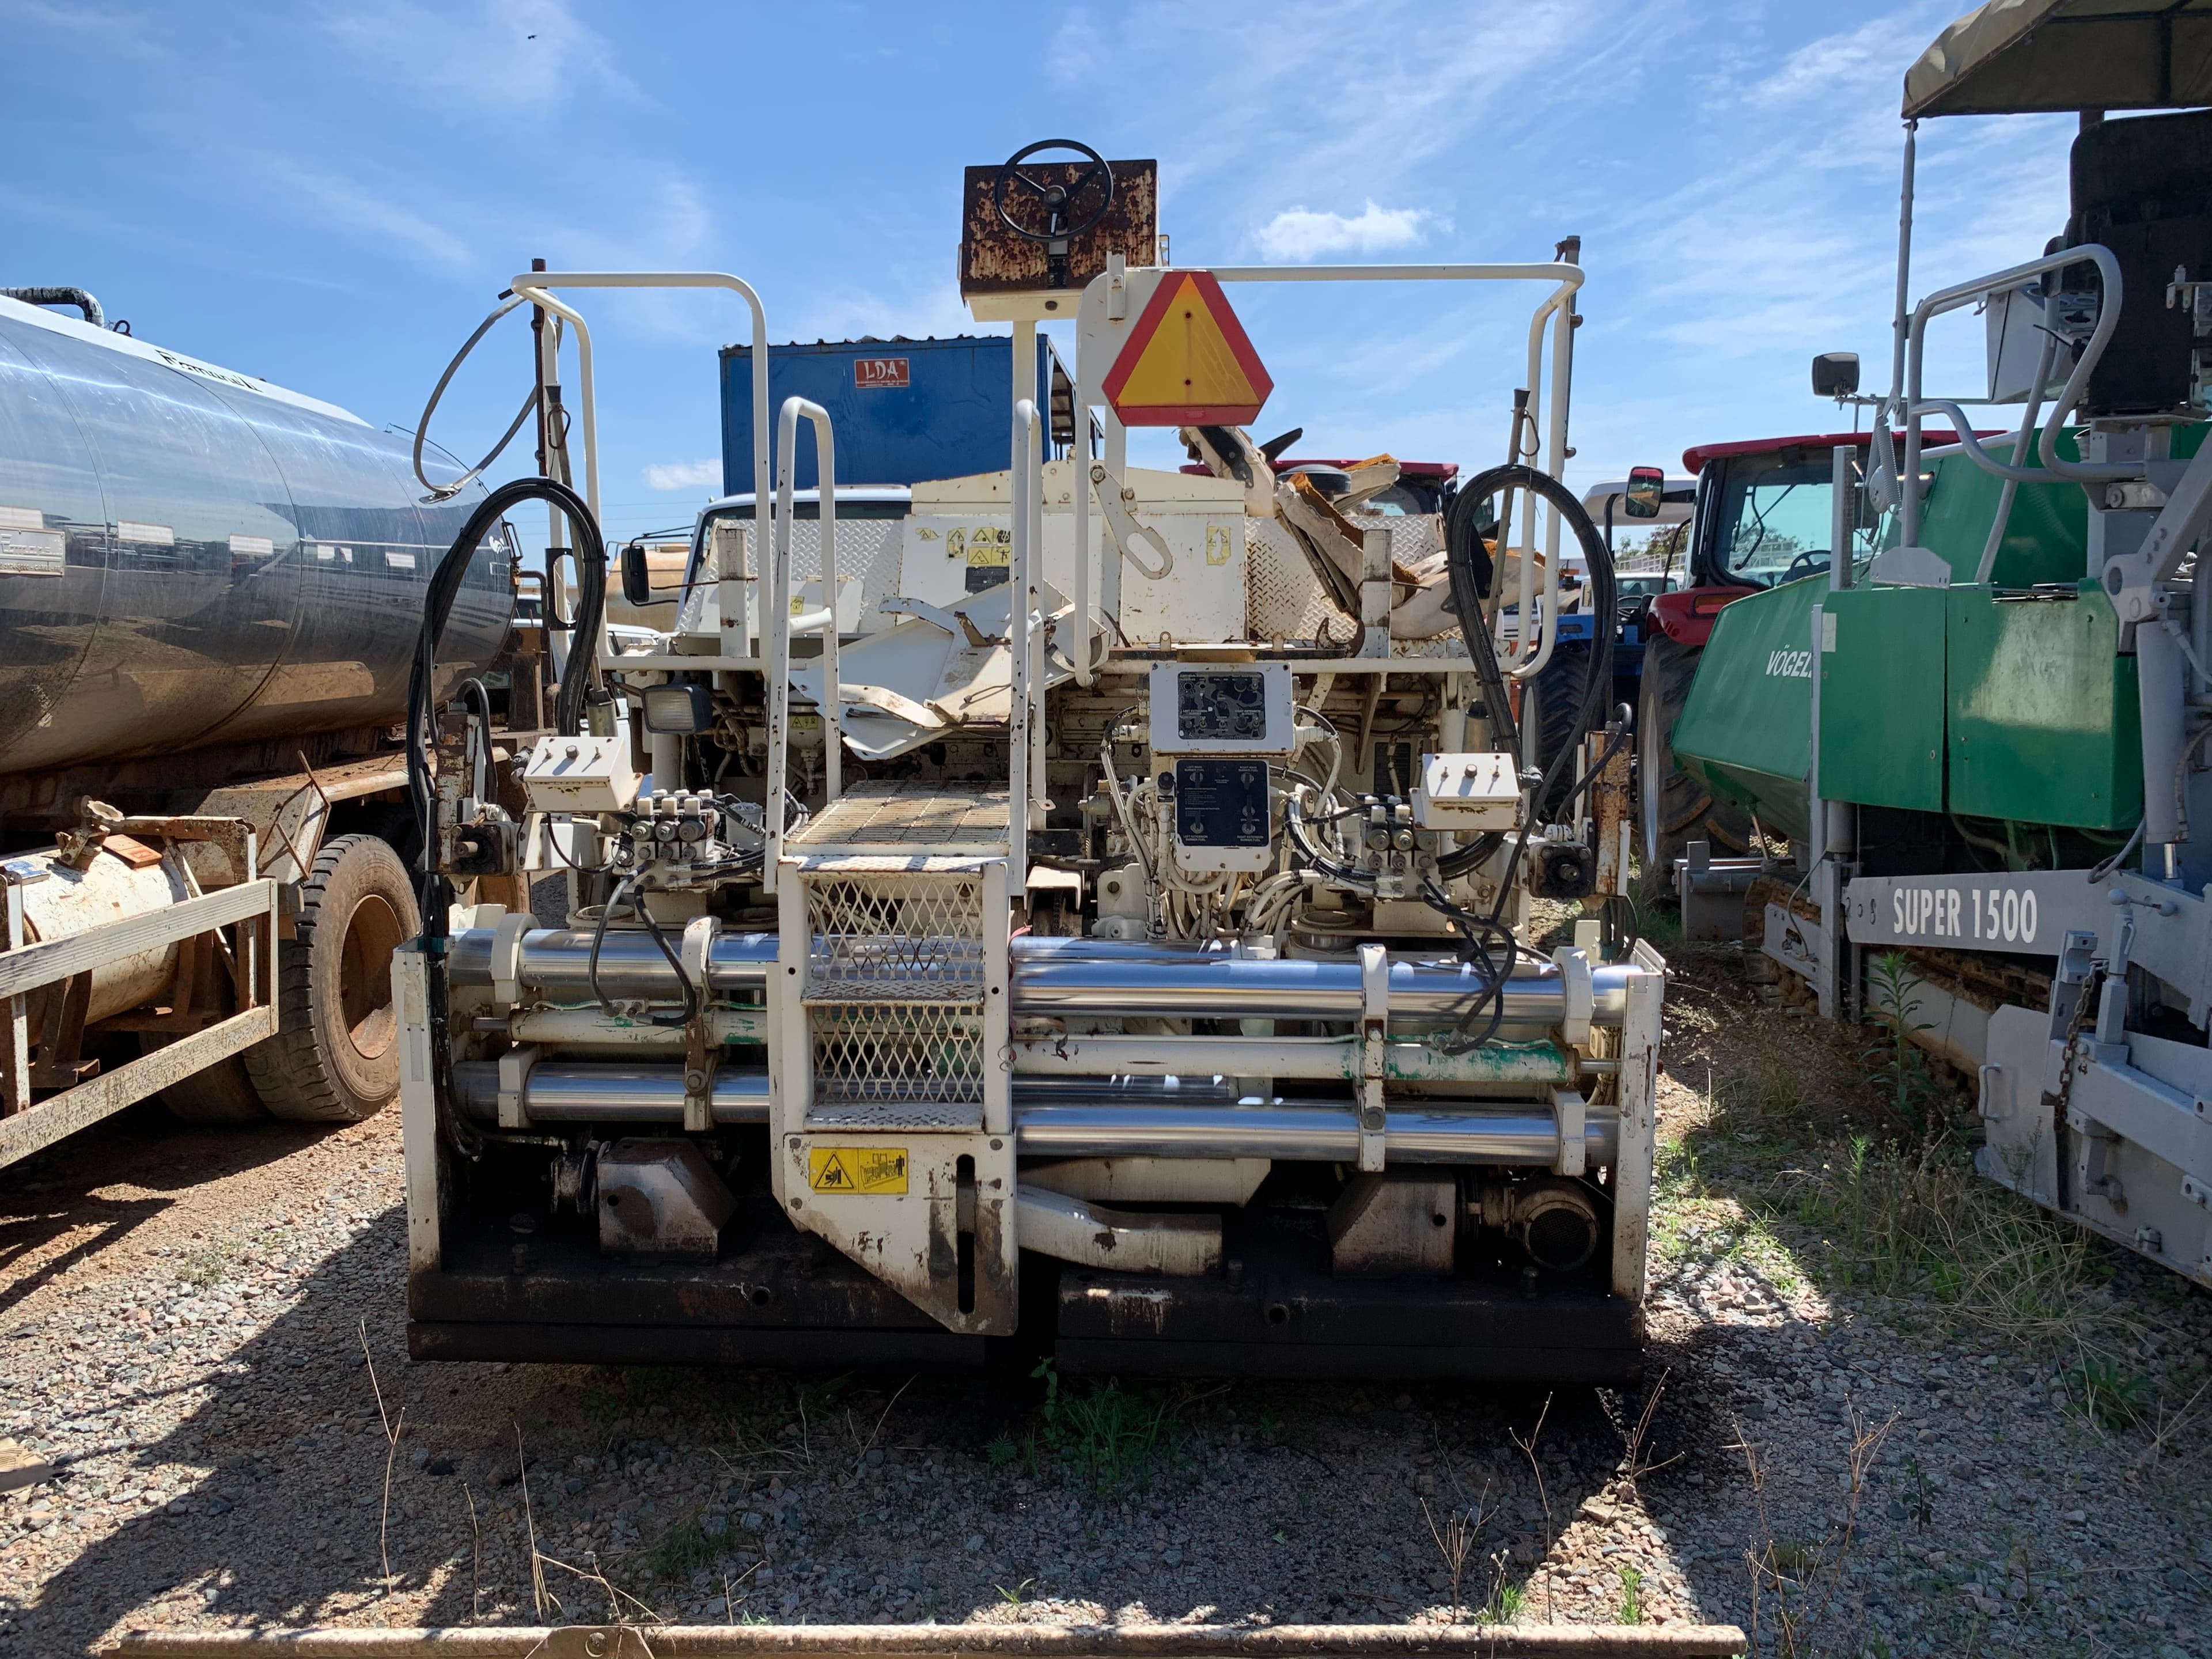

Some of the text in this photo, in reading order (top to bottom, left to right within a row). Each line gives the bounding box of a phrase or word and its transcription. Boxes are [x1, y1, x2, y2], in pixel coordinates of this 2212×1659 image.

[863, 361, 899, 380] LDA
[1765, 644, 1812, 679] VÖGEL
[1893, 888, 2038, 944] SUPER 1500
